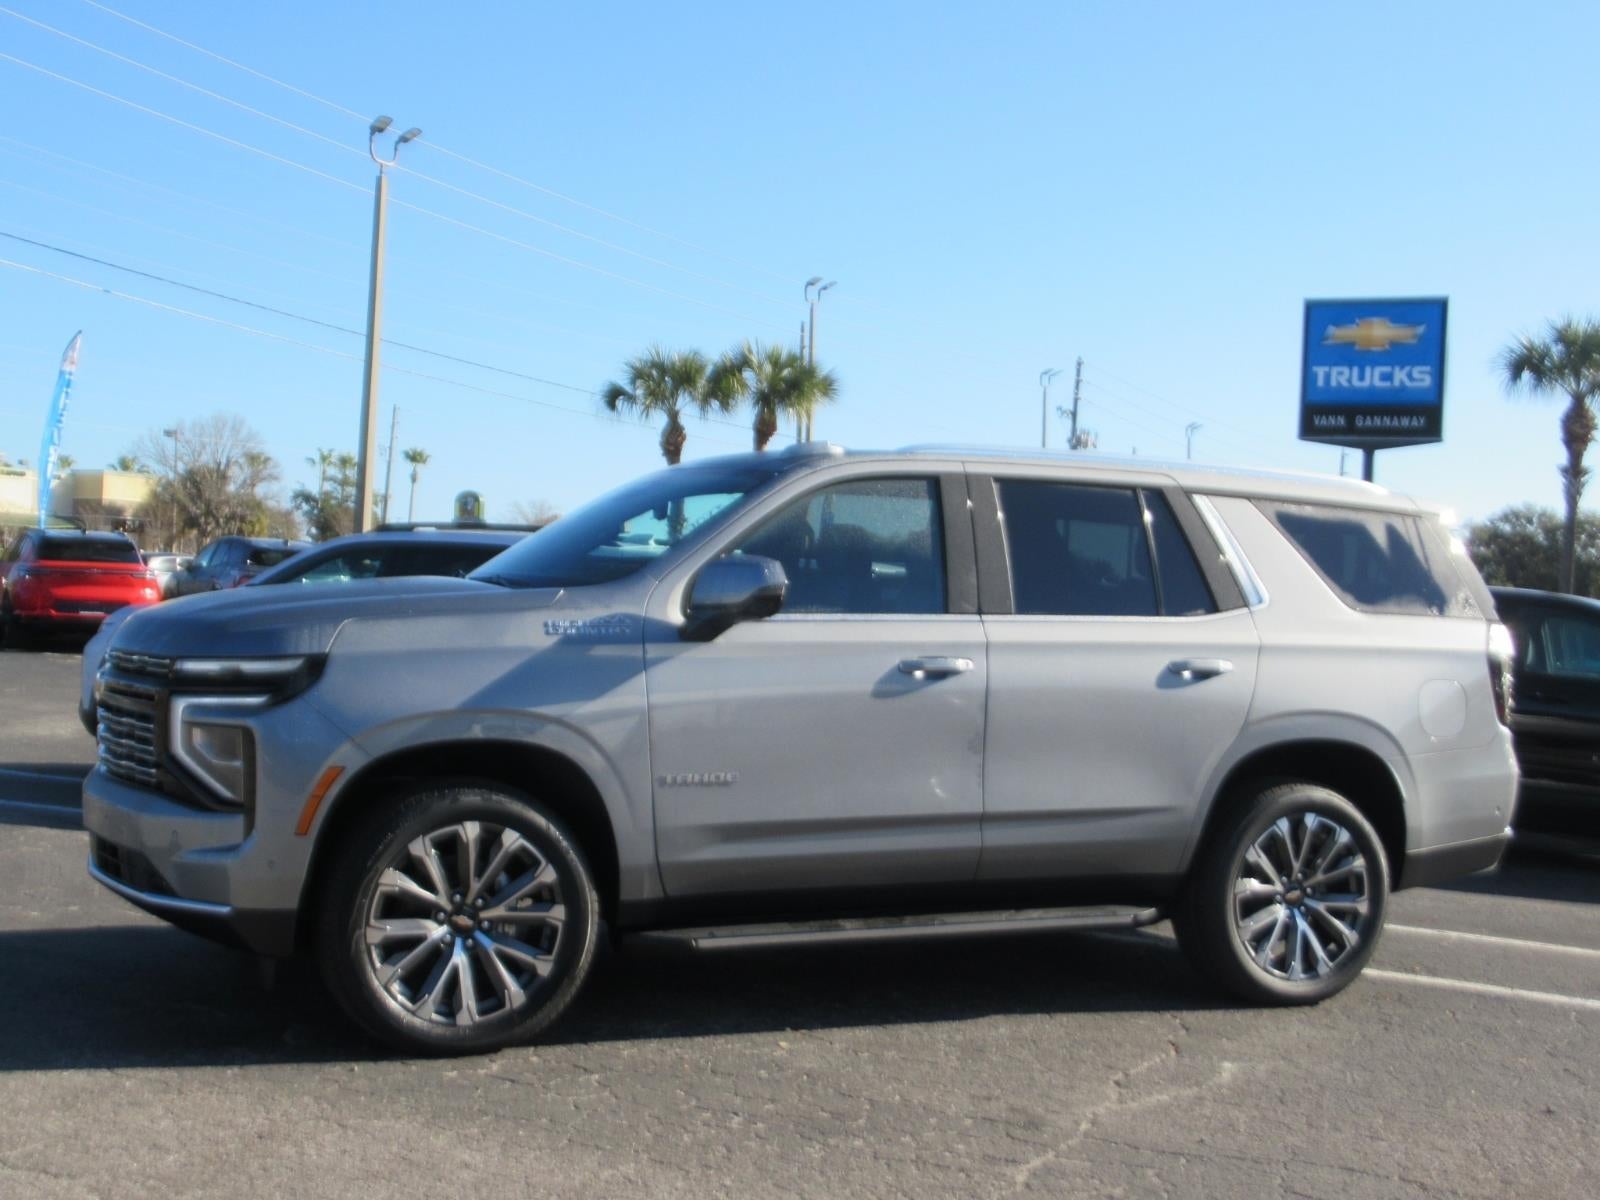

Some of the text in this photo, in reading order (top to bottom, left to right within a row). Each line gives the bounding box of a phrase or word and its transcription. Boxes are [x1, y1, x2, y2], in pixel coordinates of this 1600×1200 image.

[1312, 365, 1432, 387] TRUCKS
[1313, 414, 1426, 427] VANN GANNAWAY
